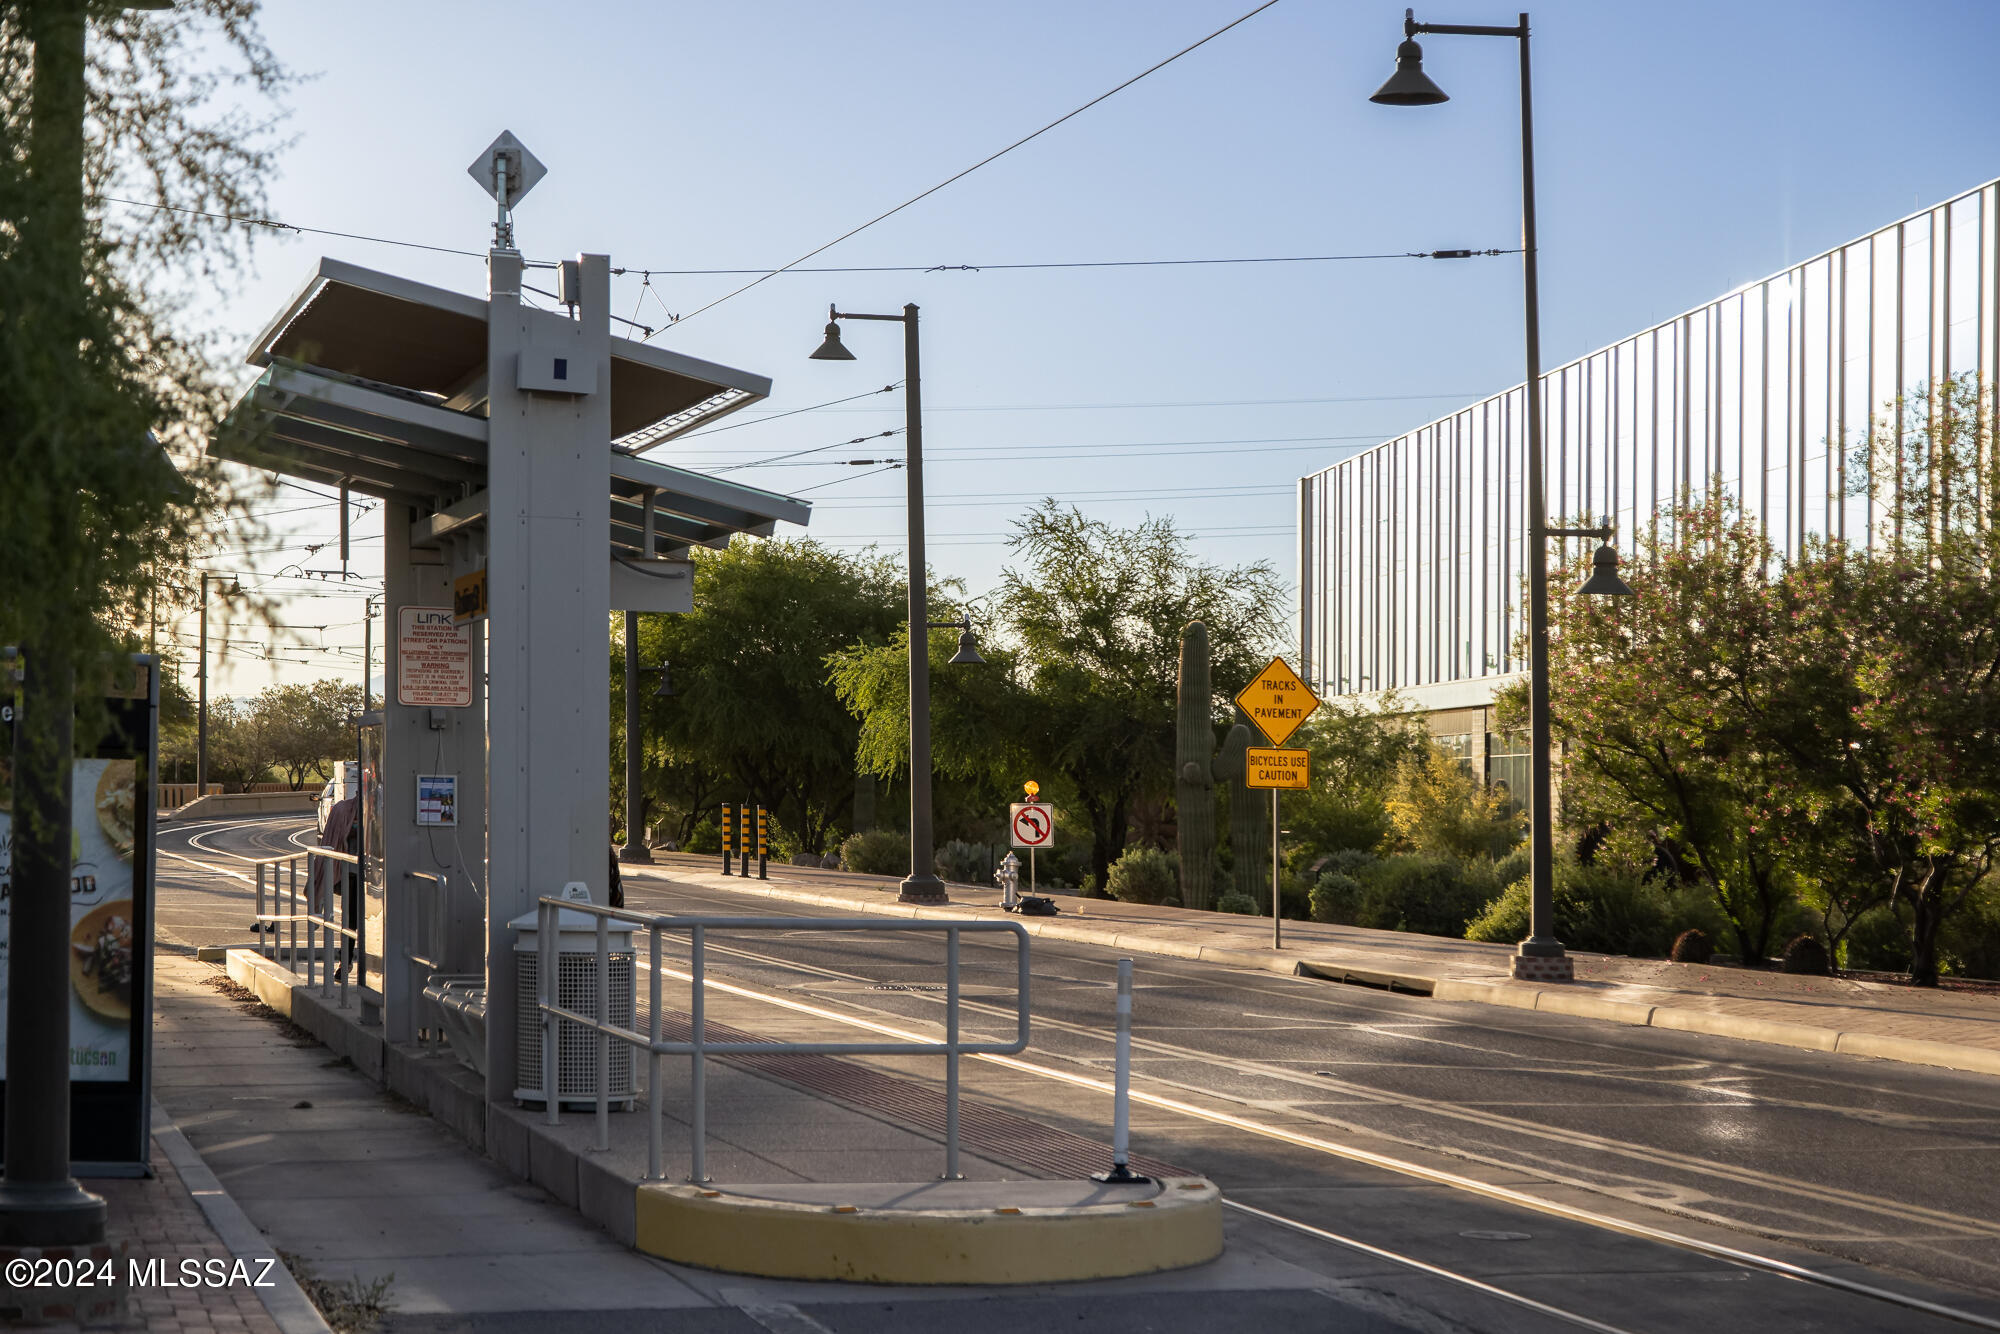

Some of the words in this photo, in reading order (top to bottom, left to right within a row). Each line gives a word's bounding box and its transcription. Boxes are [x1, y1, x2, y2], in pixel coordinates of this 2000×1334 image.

[1261, 680, 1296, 691] TRACKS
[1274, 694, 1283, 704] IN
[1254, 708, 1303, 719] PAVEMENT
[1250, 756, 1288, 766] BICYCLES
[1291, 757, 1306, 767] USE
[1259, 770, 1298, 780] CAUTION
